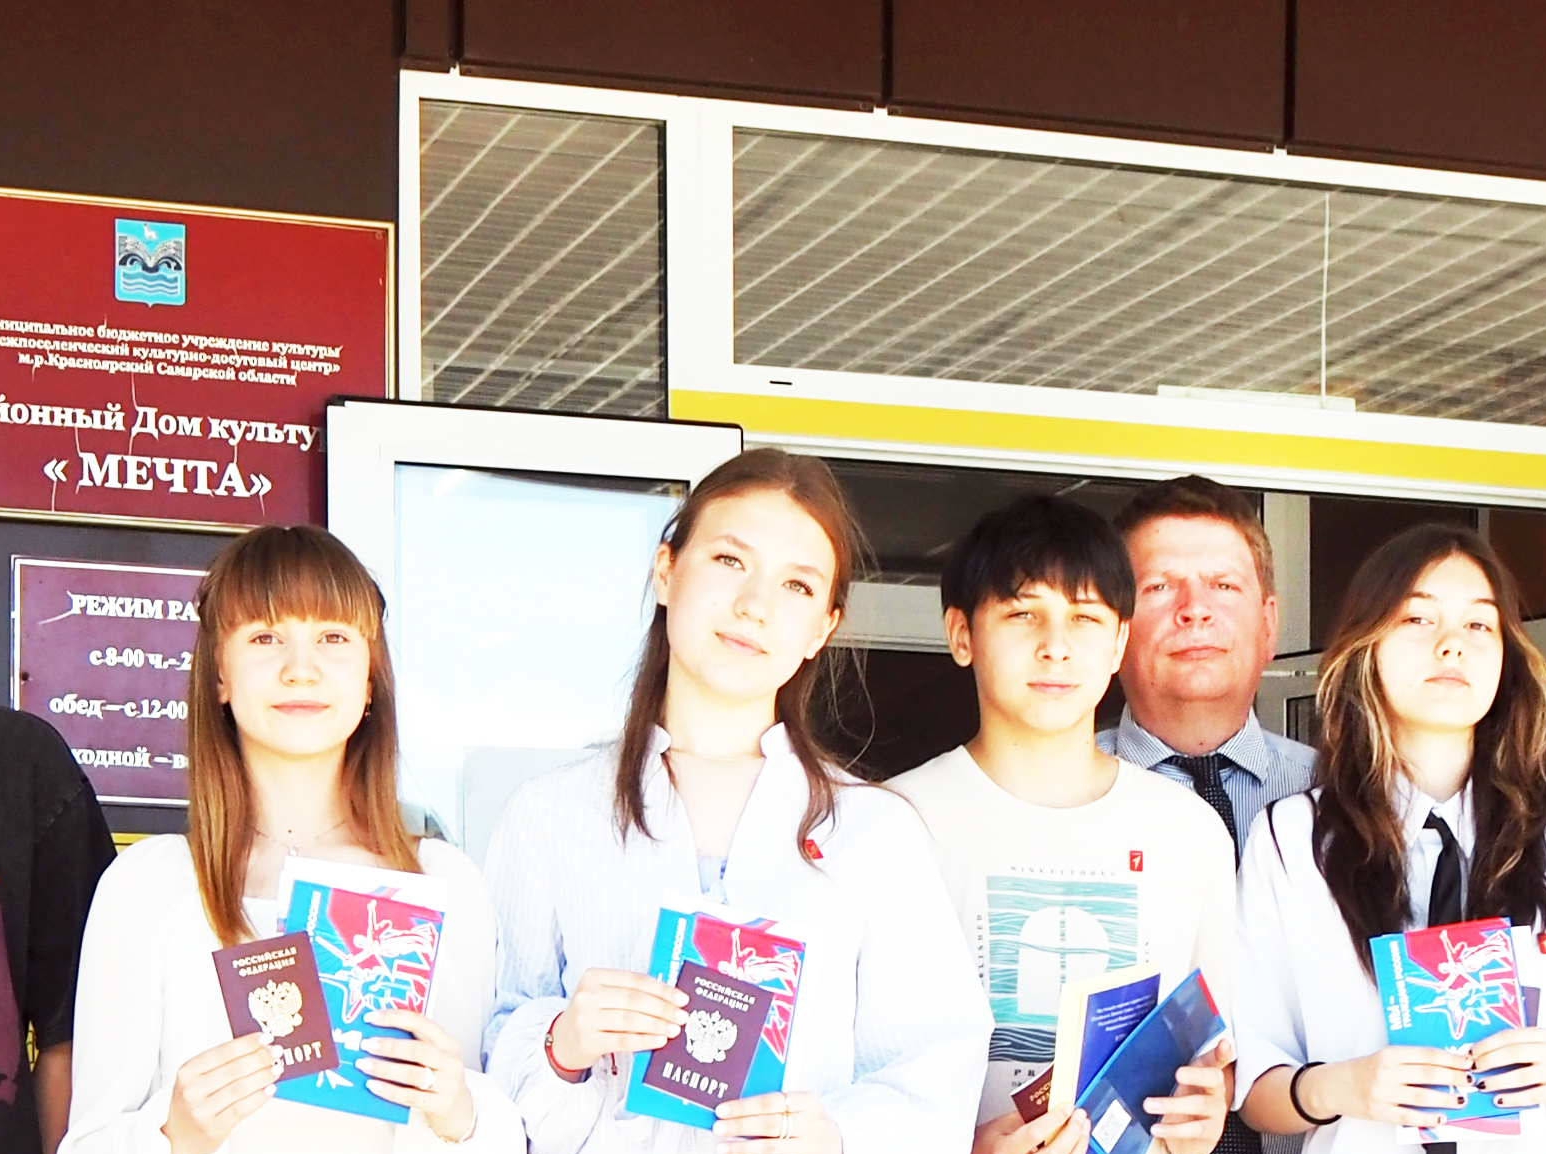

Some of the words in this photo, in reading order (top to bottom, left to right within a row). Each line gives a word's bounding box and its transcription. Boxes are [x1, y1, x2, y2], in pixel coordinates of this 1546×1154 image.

[97, 324, 180, 345] бюджетное
[181, 334, 270, 353] учреждение
[271, 342, 342, 358] культуры
[132, 347, 288, 369] культурно-досуговый
[156, 362, 236, 381] Самарской
[237, 369, 297, 386] области
[131, 406, 202, 440] Дом
[209, 416, 326, 452] культу
[71, 593, 164, 620] РЕЖИМ
[167, 600, 201, 622] РА
[71, 746, 153, 769] ходной
[232, 946, 297, 969] РОССИЙСКАЯ
[239, 957, 296, 977] ФЕДЕРАЦИЯ
[1389, 940, 1404, 980] РОССИИ
[695, 976, 755, 1005] РОССИЙСКАЯ
[695, 986, 750, 1012] ФЕДЕРАЦИЯ
[1387, 1005, 1402, 1030] МЫ
[283, 1041, 322, 1066] ПОРТ
[662, 1061, 729, 1099] ПАСПОРТ
